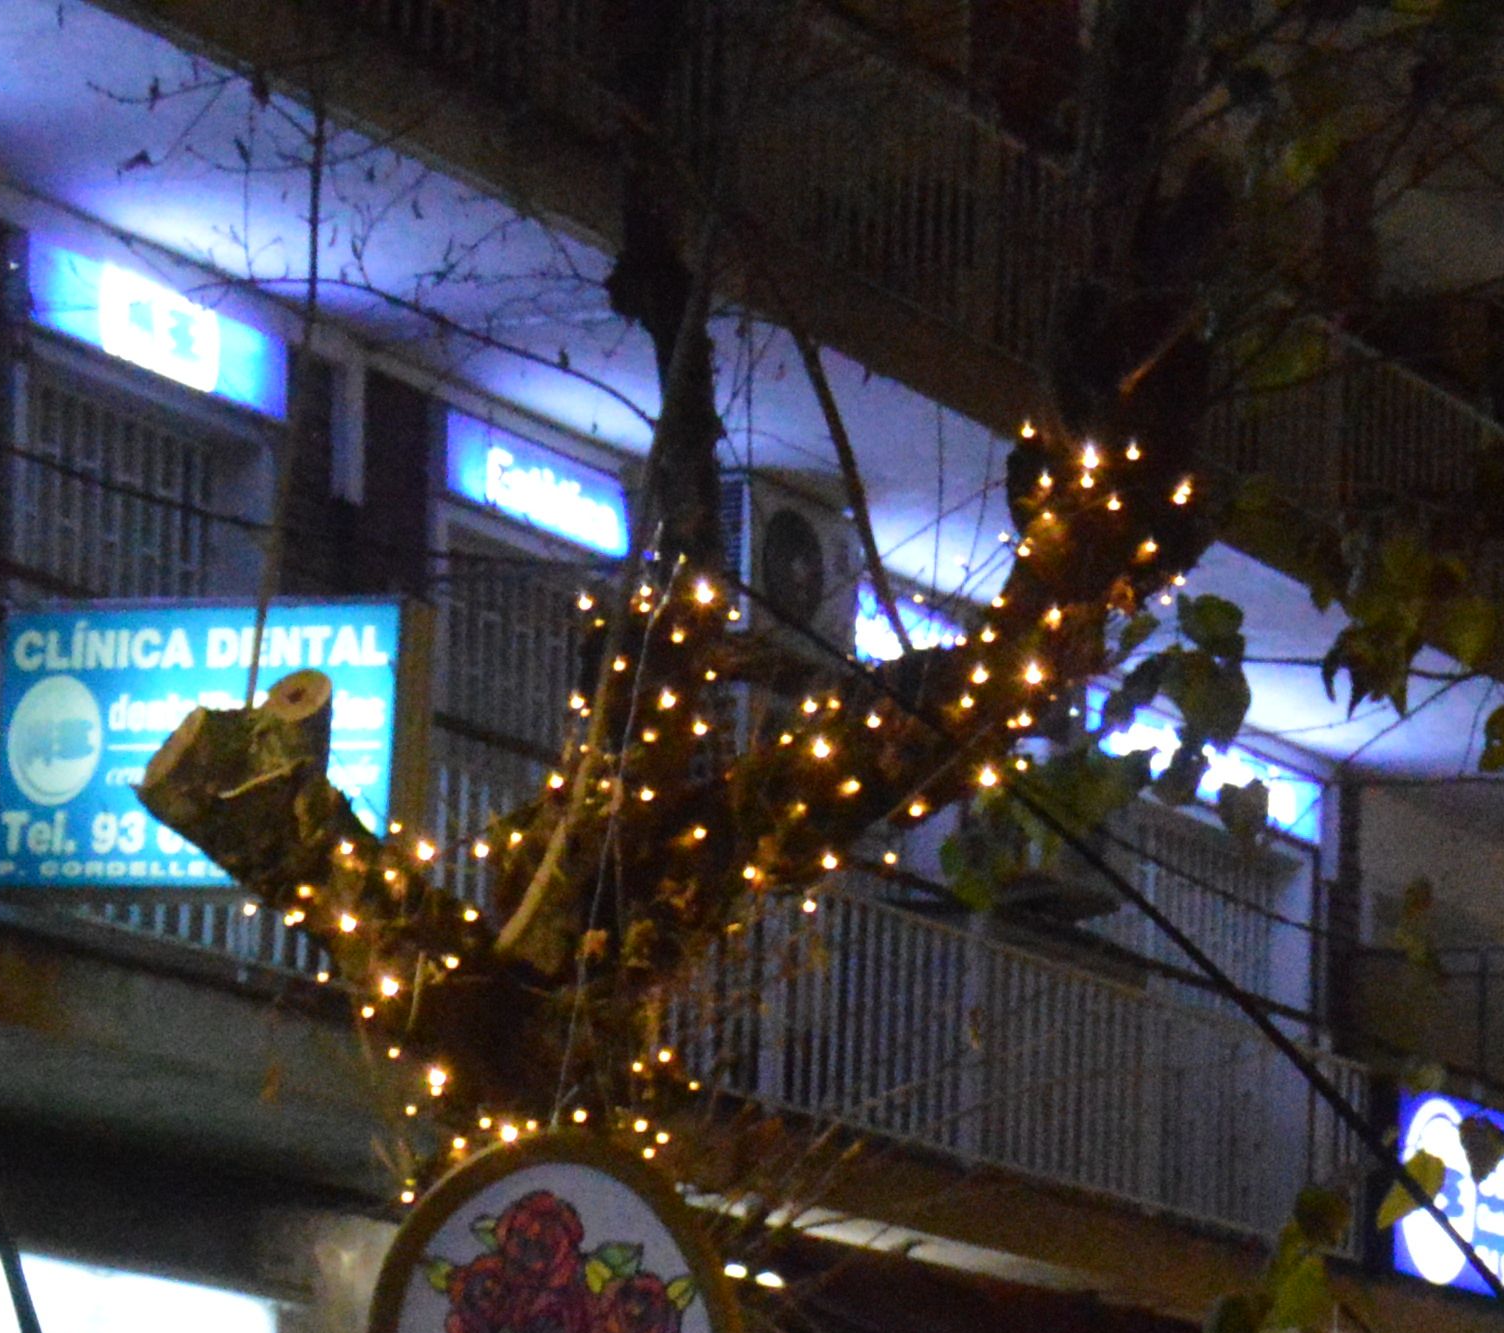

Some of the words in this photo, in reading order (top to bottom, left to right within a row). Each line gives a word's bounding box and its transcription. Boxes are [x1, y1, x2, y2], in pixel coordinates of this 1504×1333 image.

[13, 620, 194, 673] CLÍNICA
[205, 624, 388, 669] DENTAL
[1, 810, 76, 855] Tel.
[91, 811, 146, 854] 93
